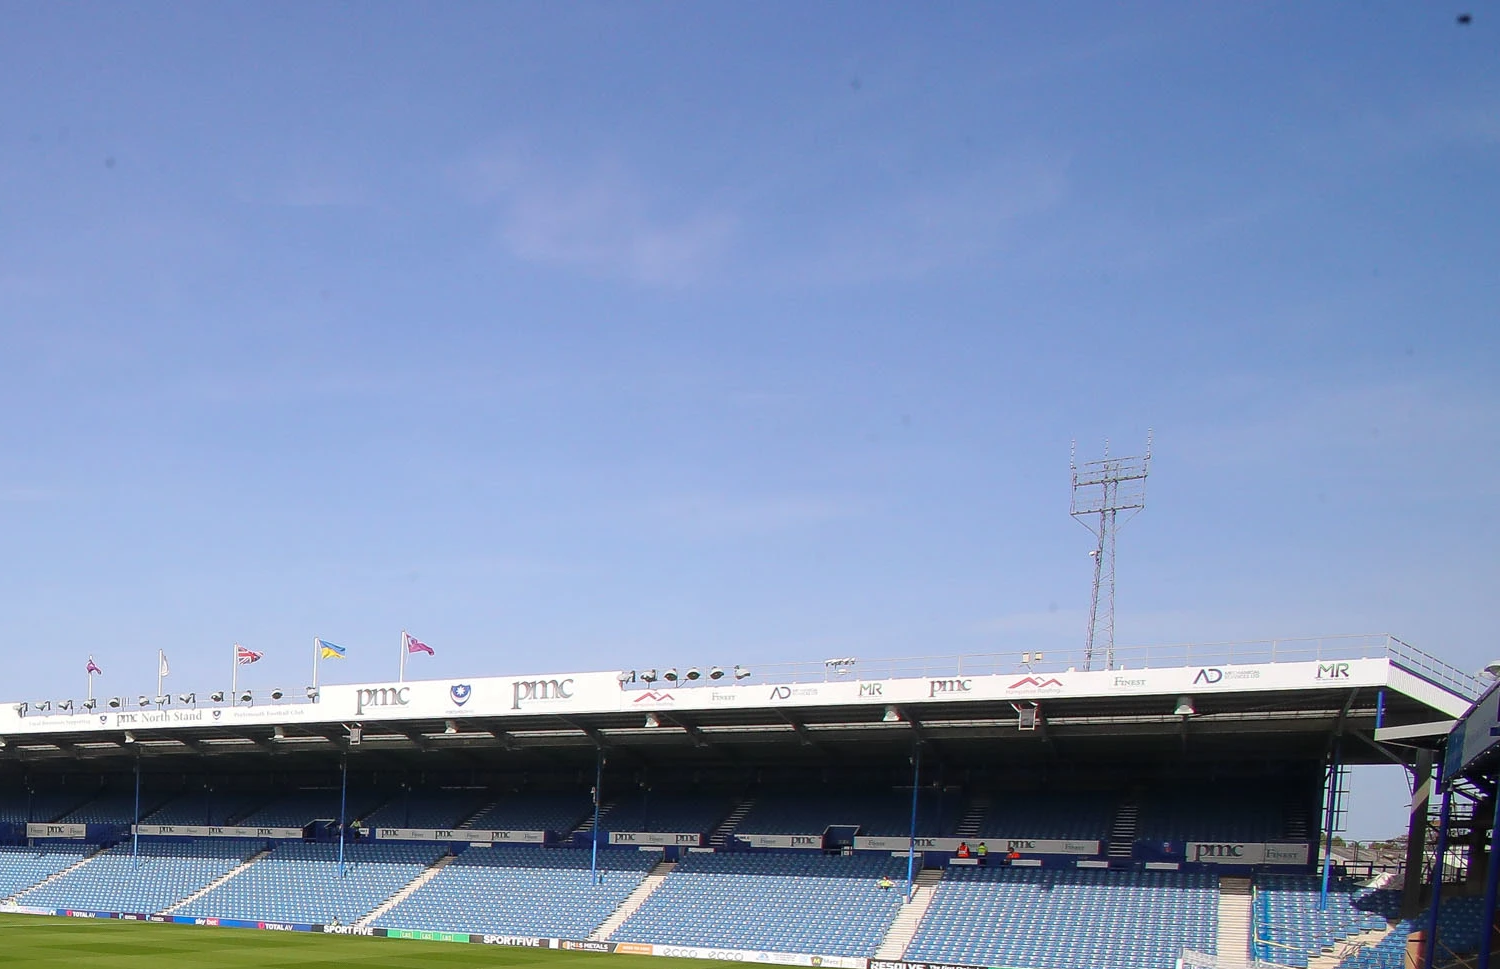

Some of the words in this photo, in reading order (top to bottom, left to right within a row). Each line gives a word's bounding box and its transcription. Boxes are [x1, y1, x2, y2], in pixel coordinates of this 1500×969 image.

[1315, 662, 1349, 678] MR
[511, 678, 574, 709] pmc
[860, 683, 882, 696] MR
[928, 679, 972, 697] pmc
[355, 686, 410, 715] pmc
[116, 713, 138, 727] pmc
[141, 712, 171, 723] North
[173, 710, 202, 721] Stand
[47, 826, 65, 836] pmc
[159, 826, 174, 834] pmc
[208, 827, 223, 835] pmc
[257, 828, 272, 837] pmc
[381, 829, 399, 838] pmc
[435, 831, 454, 840] pmc
[491, 831, 511, 840] pmc
[614, 834, 635, 843] pmc
[675, 834, 698, 844] pmc
[791, 836, 816, 846] pmc
[1195, 844, 1244, 861] pmc
[483, 935, 540, 947] SPORTFIVE
[663, 948, 698, 958] ecco
[708, 951, 744, 961] ecco
